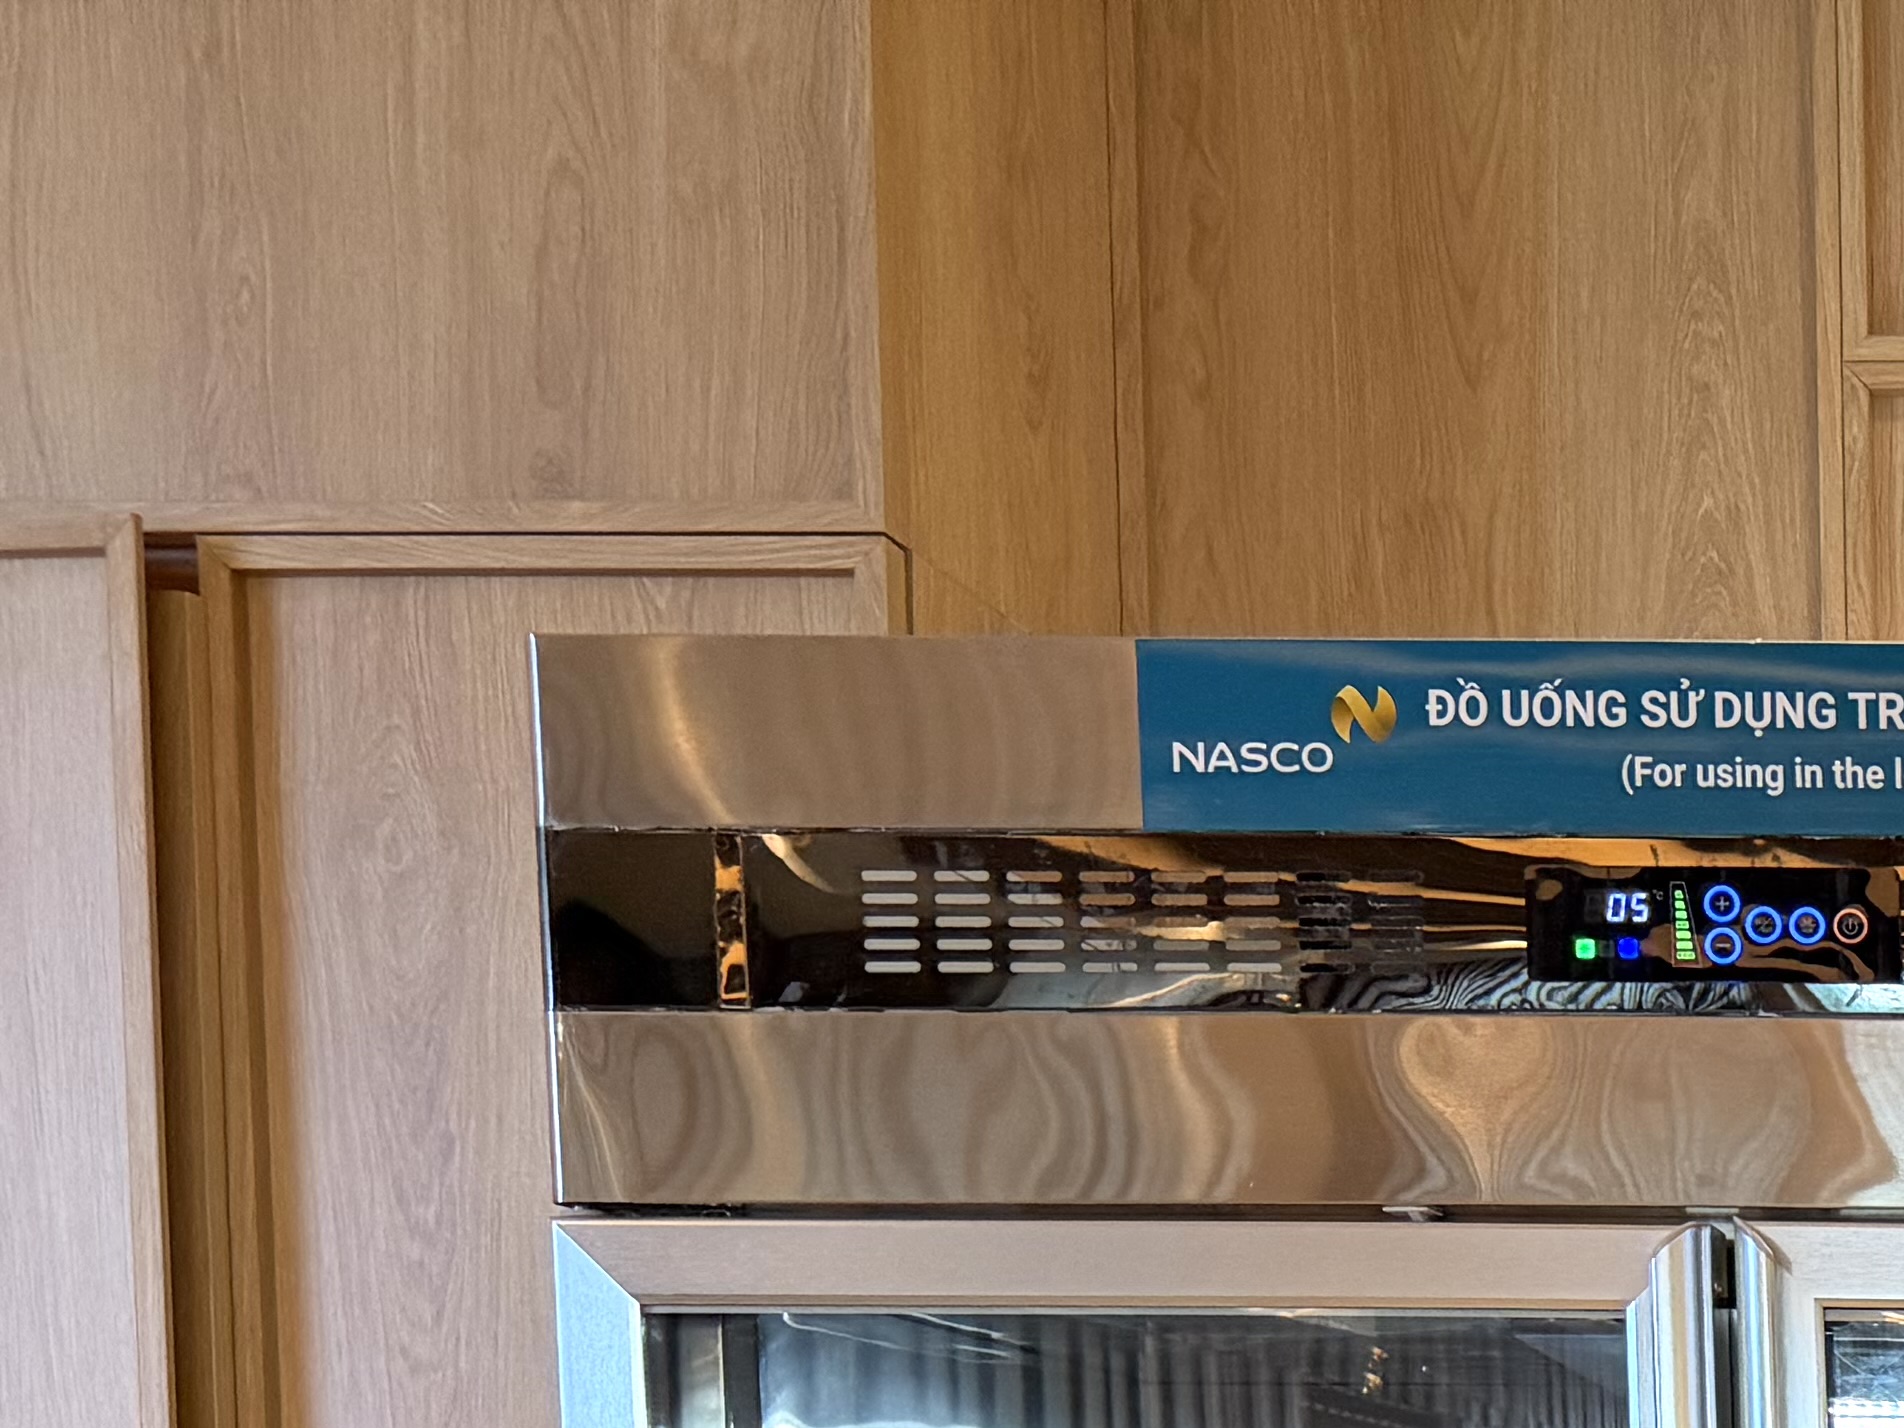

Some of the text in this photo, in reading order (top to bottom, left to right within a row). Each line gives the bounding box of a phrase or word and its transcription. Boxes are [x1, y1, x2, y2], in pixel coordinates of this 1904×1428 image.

[1425, 677, 1489, 727] ĐỒ
[1502, 677, 1627, 728] UỐNG
[1640, 677, 1705, 729] SỬ
[1713, 690, 1838, 737] DỤNG
[1171, 741, 1334, 773] NASCO
[1621, 753, 1687, 795] (For
[1696, 757, 1785, 796] using
[1794, 756, 1825, 789] in
[1832, 756, 1885, 790] the
[1605, 892, 1649, 923] 05
